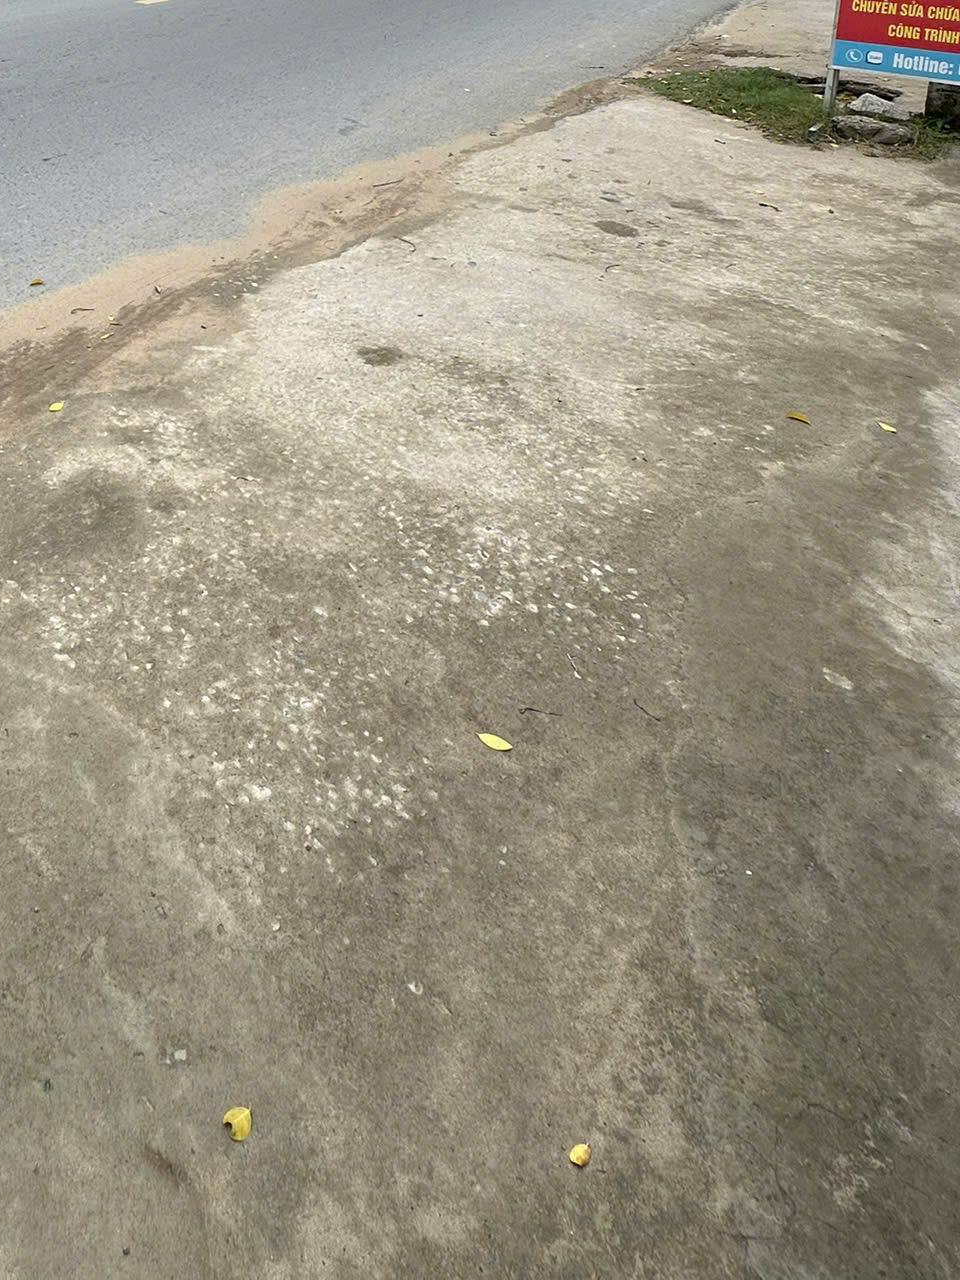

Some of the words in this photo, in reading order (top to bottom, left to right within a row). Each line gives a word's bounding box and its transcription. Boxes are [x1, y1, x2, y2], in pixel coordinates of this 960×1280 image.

[852, 0, 897, 15] CHUYÊN
[900, 0, 924, 18] SỬA
[888, 22, 921, 40] CÔNG
[924, 27, 960, 44] TRÌNH
[892, 52, 954, 75] Hotline:
